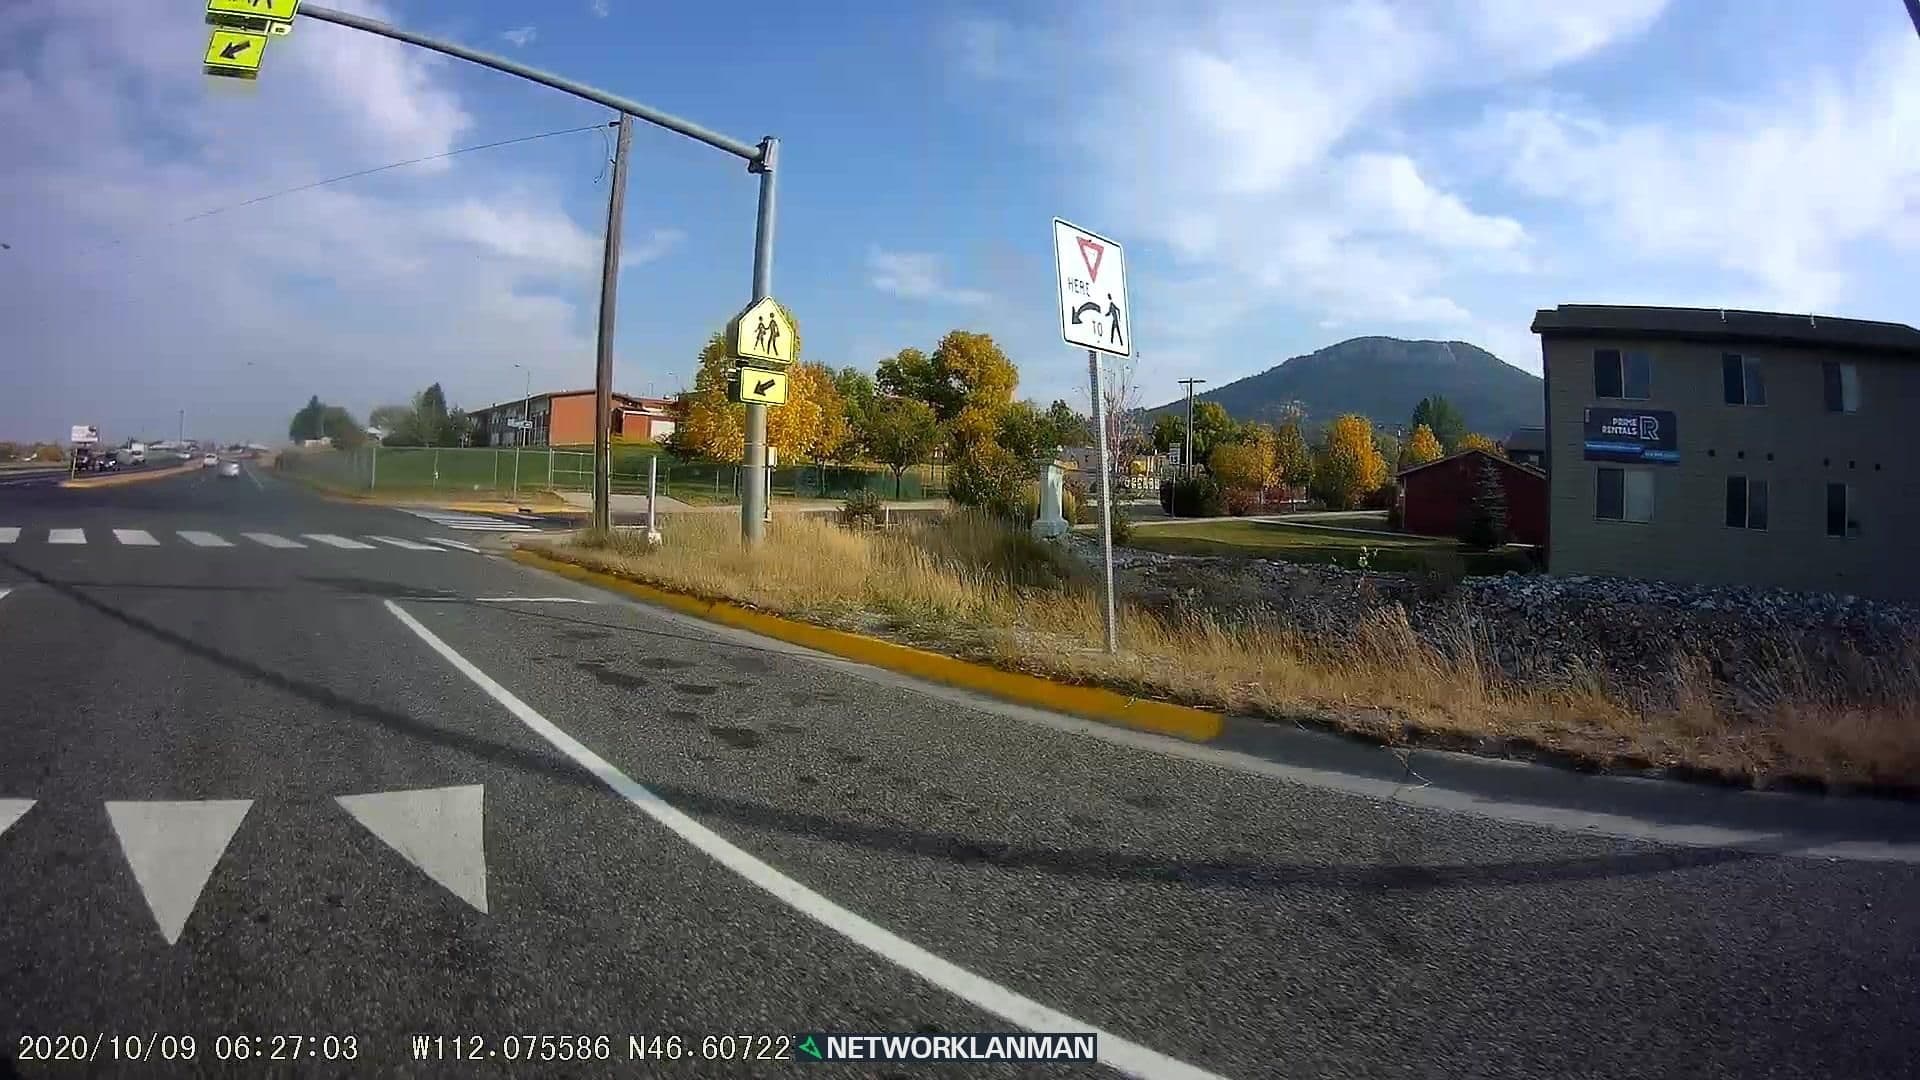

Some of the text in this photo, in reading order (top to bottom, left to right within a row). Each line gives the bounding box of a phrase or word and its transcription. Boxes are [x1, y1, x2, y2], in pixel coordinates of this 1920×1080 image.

[1067, 276, 1091, 297] HERE
[1092, 320, 1103, 337] TO
[1612, 417, 1638, 427] PRIME
[1601, 426, 1638, 435] RENTALS
